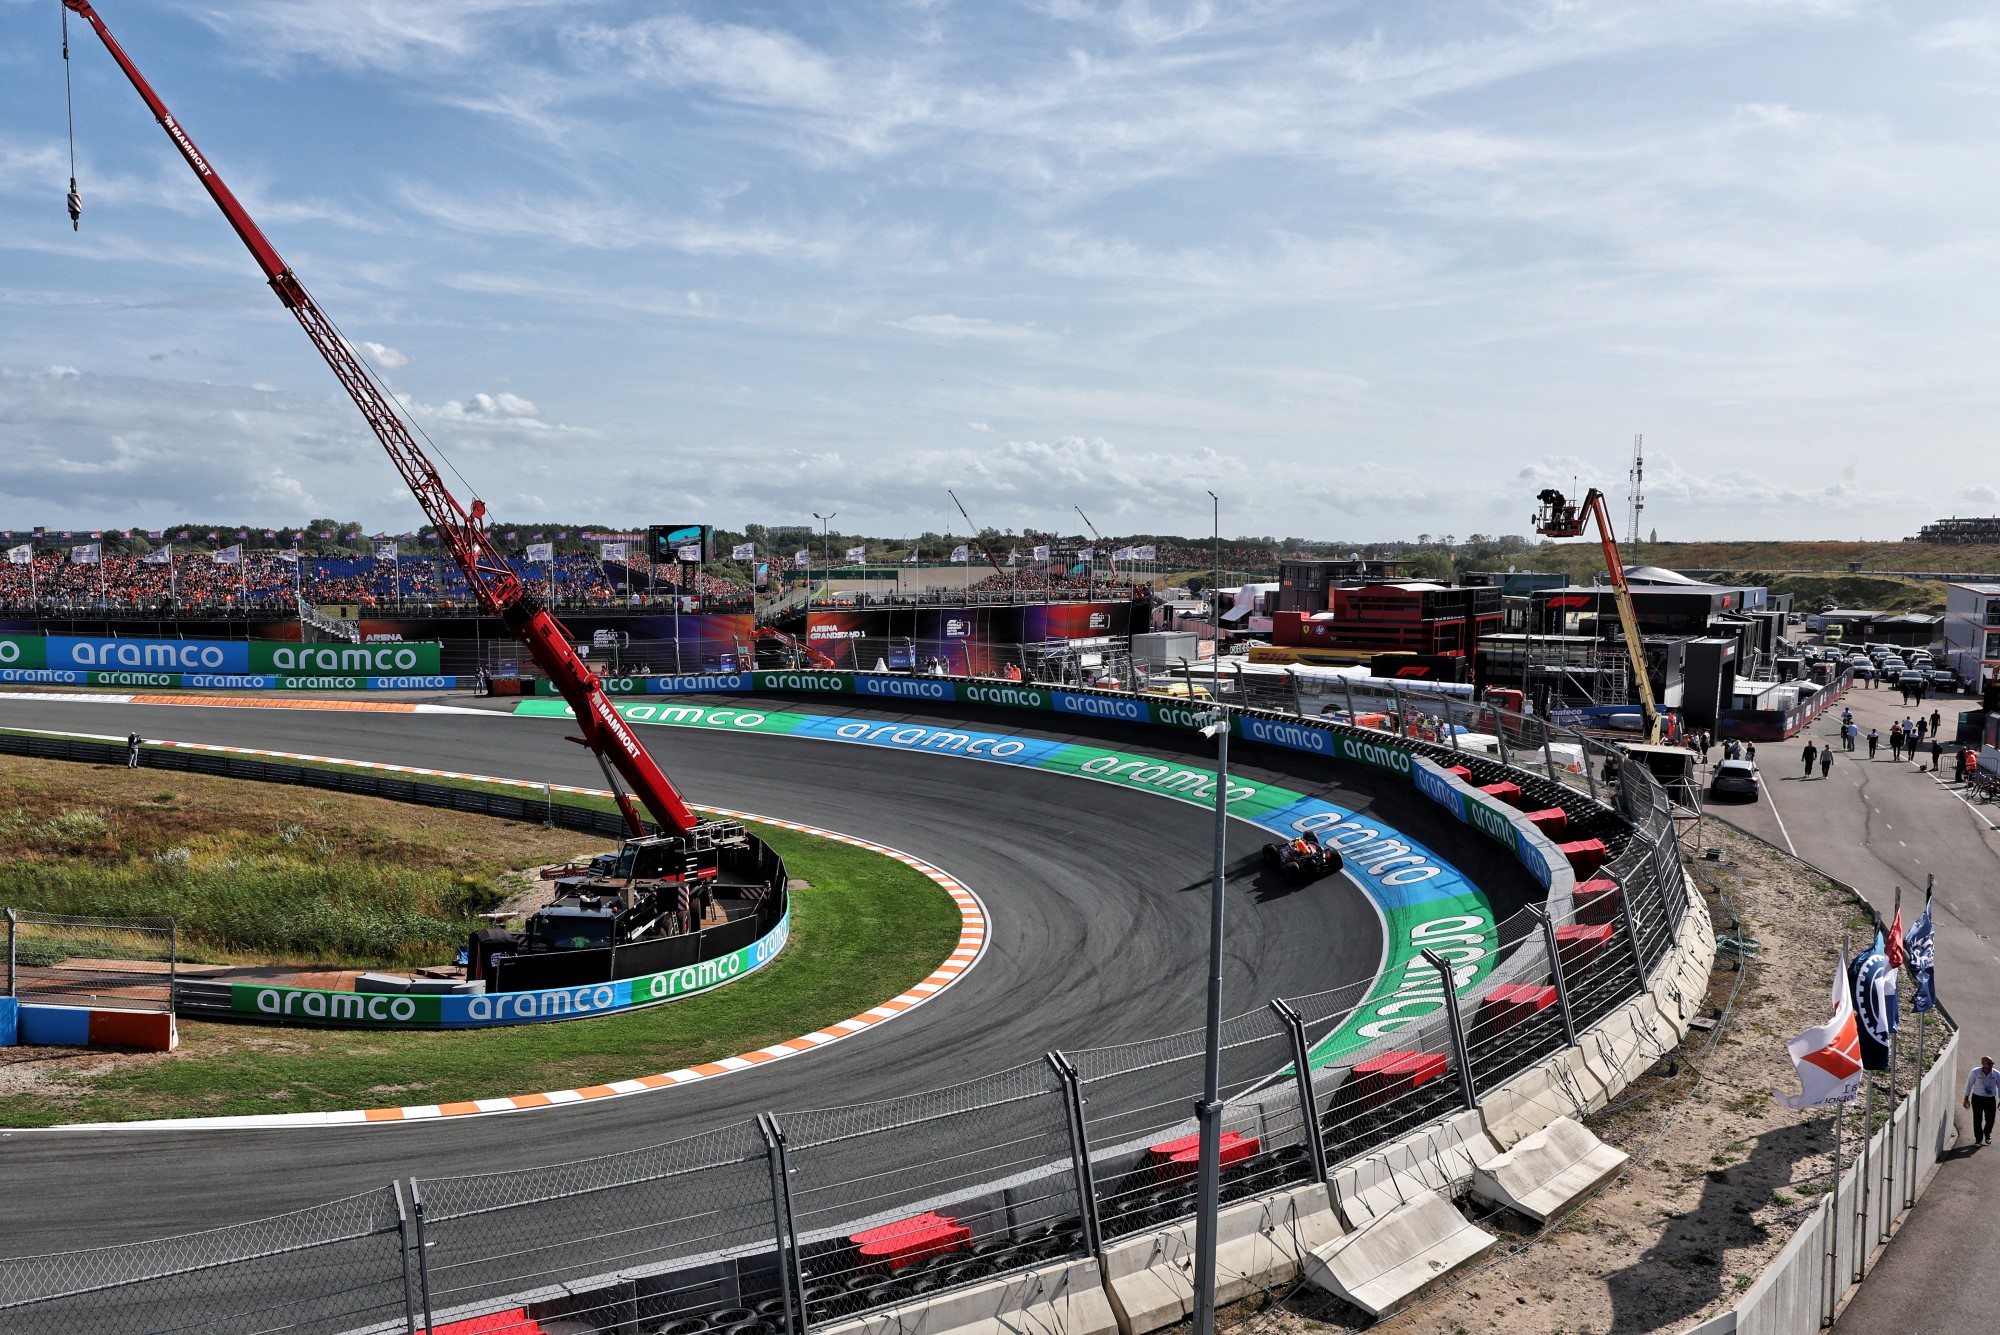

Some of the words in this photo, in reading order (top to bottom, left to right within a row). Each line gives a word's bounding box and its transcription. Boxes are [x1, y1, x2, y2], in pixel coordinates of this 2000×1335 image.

[171, 126, 212, 176] MAMMOET
[366, 633, 403, 641] ARENA
[72, 642, 224, 668] aramco
[273, 648, 416, 670] aramco
[1257, 652, 1291, 661] DHL
[3, 669, 76, 682] aramco
[98, 672, 171, 686] aramco
[192, 676, 265, 688] aramco
[286, 677, 356, 688] aramco
[377, 676, 445, 688] aramco
[659, 675, 741, 690] aramco
[765, 675, 843, 691] aramco
[867, 679, 943, 697] aramco
[967, 686, 1041, 707] aramco
[564, 704, 766, 728] amco
[1065, 696, 1138, 718] aramco
[599, 703, 641, 759] MAMMOET
[836, 723, 1026, 757] aramco
[1252, 722, 1323, 750] aramco
[1343, 739, 1409, 773] aramco
[1079, 756, 1257, 803] aramco
[1290, 811, 1442, 886] aramco
[650, 953, 740, 998] aramco
[257, 989, 416, 1021] aramco
[468, 985, 614, 1020] aramco
